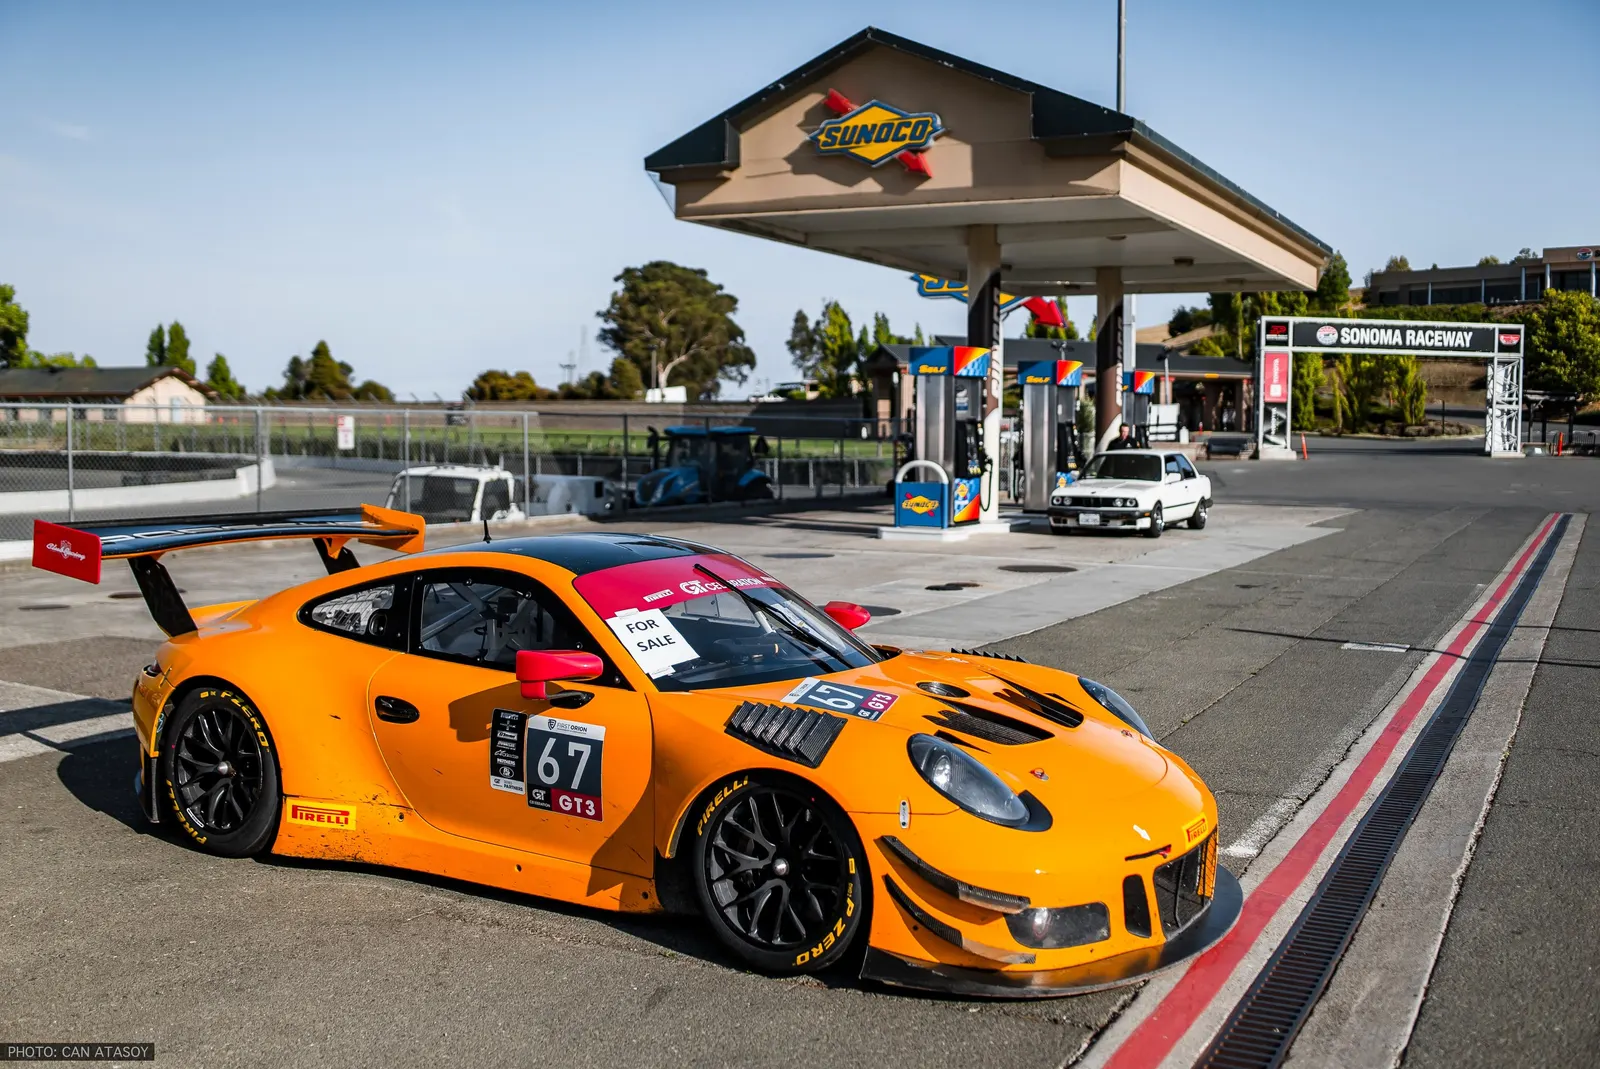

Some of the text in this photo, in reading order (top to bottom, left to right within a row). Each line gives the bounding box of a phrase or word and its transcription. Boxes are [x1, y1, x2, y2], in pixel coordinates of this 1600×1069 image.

[821, 119, 931, 147] SUNOCO
[1341, 327, 1403, 346] SONOMA
[1406, 330, 1473, 348] RACEWAY
[679, 580, 708, 595] GT
[625, 619, 660, 634] FOR
[637, 634, 676, 652] SALE
[808, 685, 864, 710] 67
[868, 694, 892, 710] GT3
[231, 696, 270, 748] ZERO
[557, 721, 571, 730] FIRST
[570, 725, 588, 733] ORION
[537, 737, 592, 790] 67
[532, 789, 546, 801] GT
[559, 795, 596, 816] GT3
[697, 775, 749, 836] PIRELLI
[166, 779, 207, 845] PIRELLI
[292, 804, 350, 825] PIRELLI
[1186, 818, 1207, 843] PIRELLI
[796, 897, 856, 966] P ZERO
